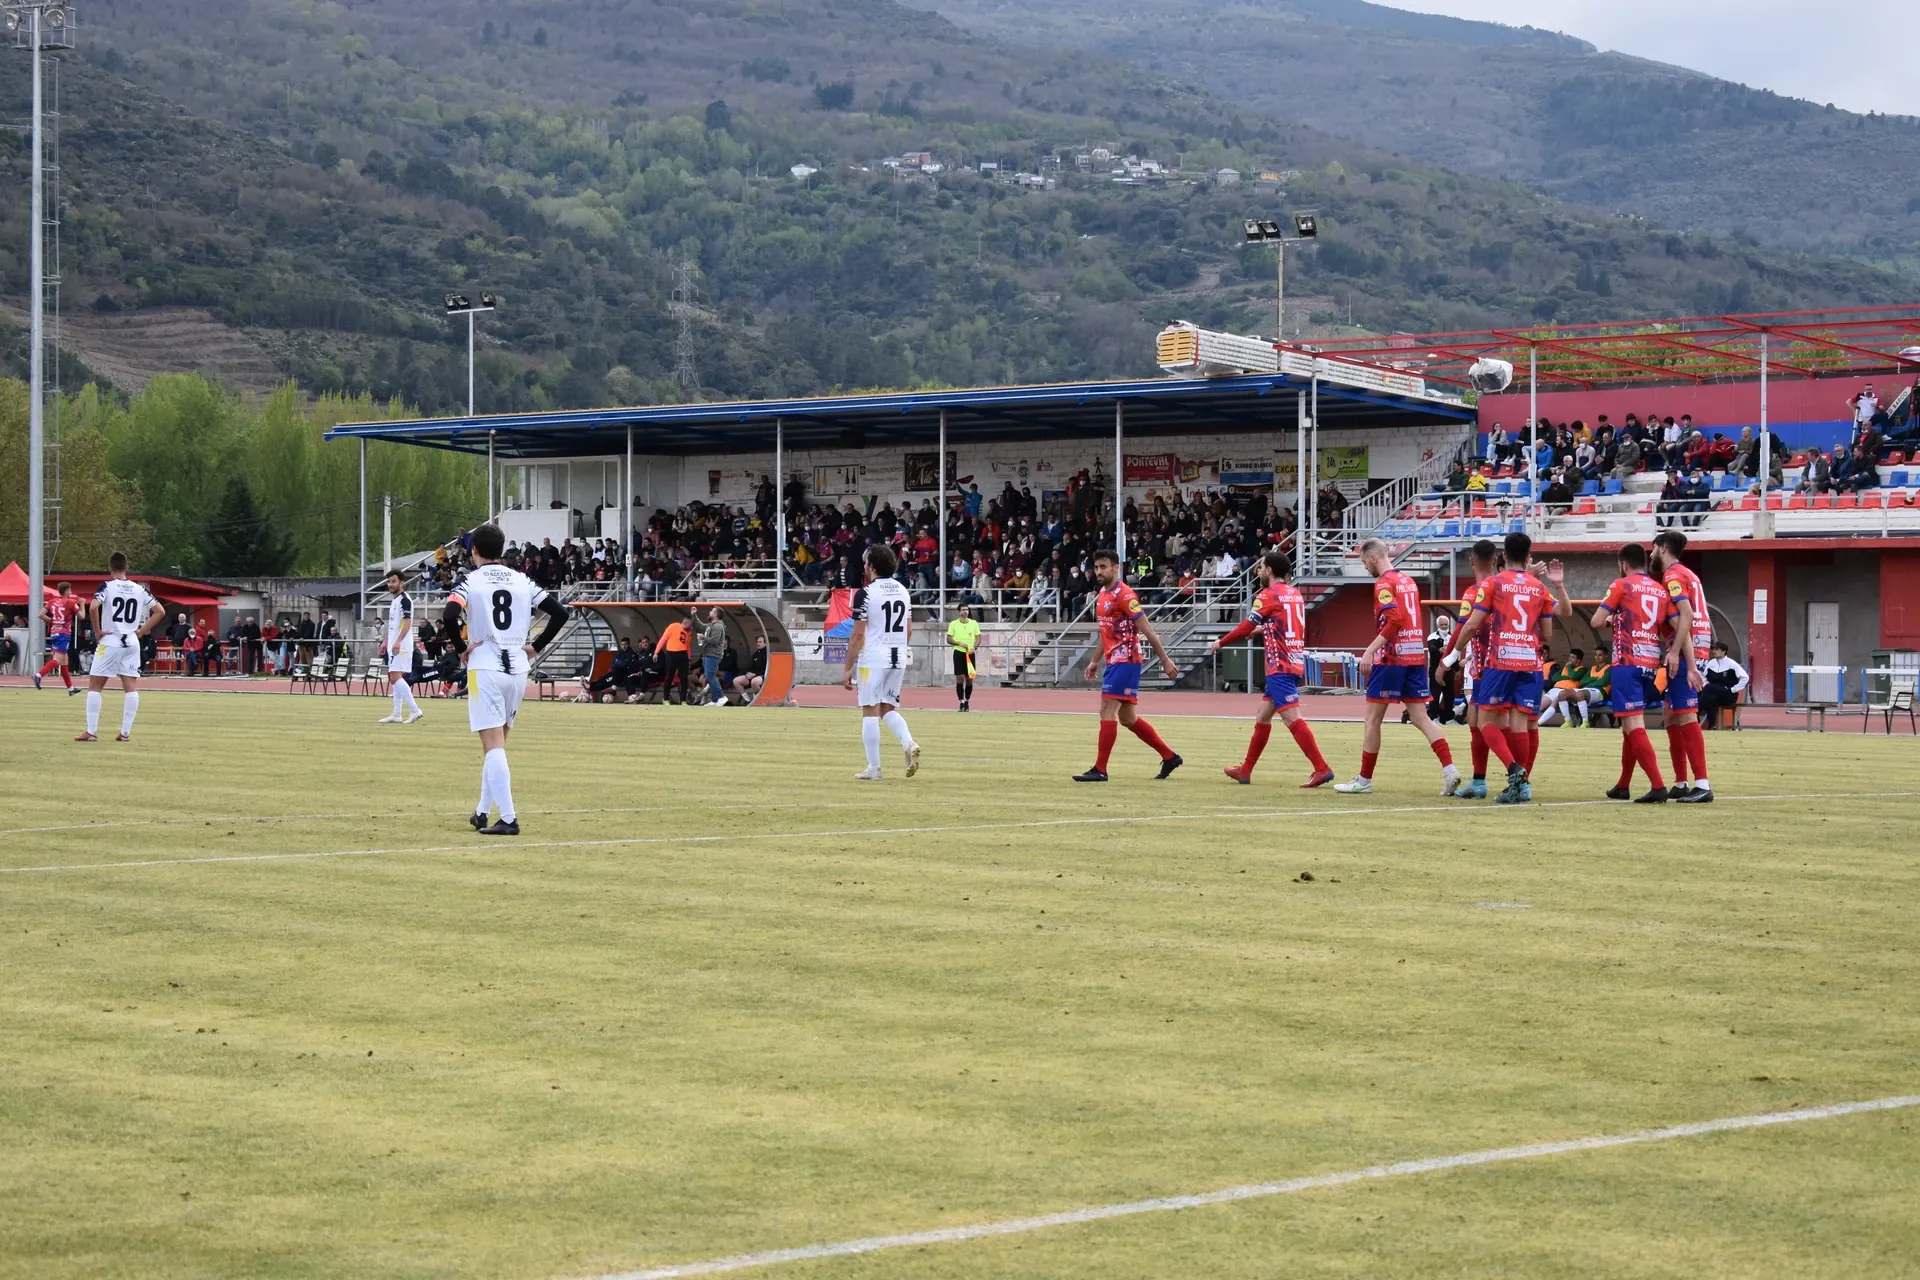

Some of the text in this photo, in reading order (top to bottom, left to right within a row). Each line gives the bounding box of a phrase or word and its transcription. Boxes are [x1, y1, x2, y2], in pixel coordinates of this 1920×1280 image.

[1127, 456, 1169, 467] PORTEVAL
[1275, 464, 1320, 474] EXCATAS
[1502, 584, 1518, 593] IAGO
[1647, 587, 1666, 598] PAZOS
[51, 605, 66, 621] 15
[112, 597, 138, 623] 20
[492, 589, 512, 631] 8
[881, 600, 905, 632] 12
[1404, 592, 1417, 627] 4
[1512, 593, 1530, 631] 5
[1641, 594, 1658, 630] 9
[1012, 633, 1036, 646] CRUZ
